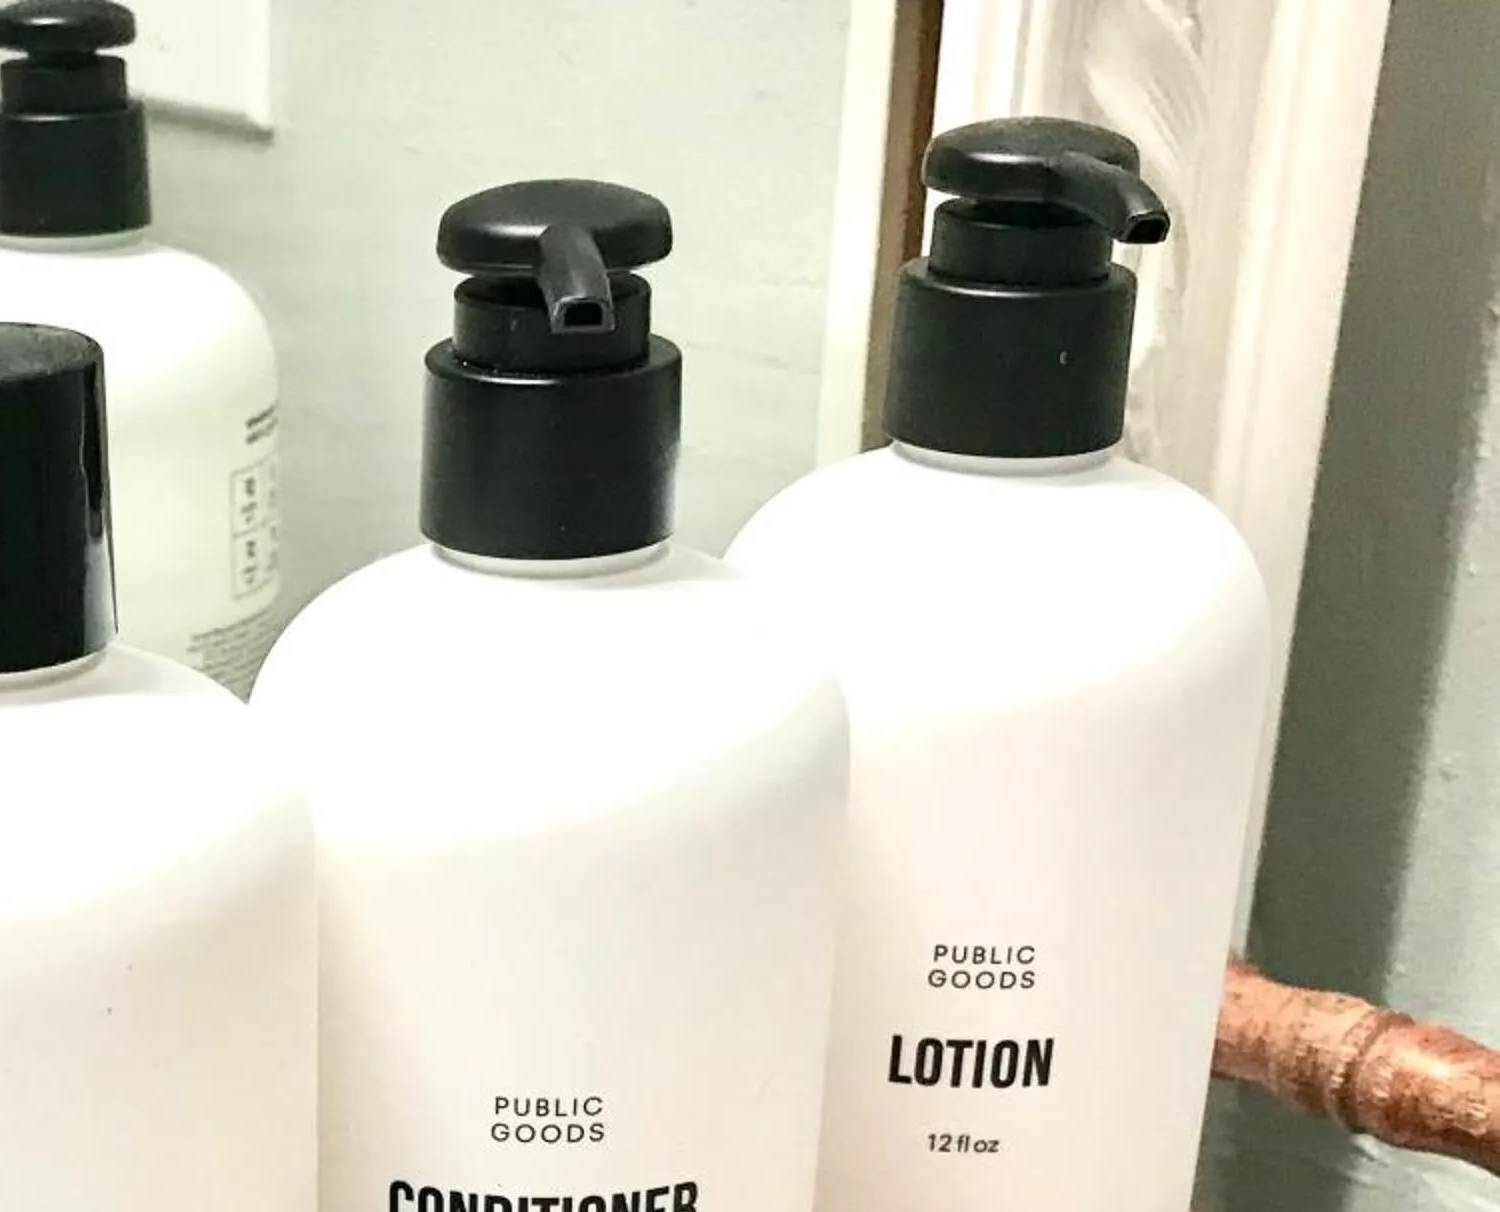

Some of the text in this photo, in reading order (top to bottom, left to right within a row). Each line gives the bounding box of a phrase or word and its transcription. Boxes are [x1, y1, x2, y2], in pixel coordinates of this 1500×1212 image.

[933, 944, 1035, 965] PUBLIC
[927, 968, 1035, 990] GOODS
[887, 1034, 1055, 1089] LOTION
[495, 1096, 603, 1118] PUBLIC
[491, 1122, 605, 1144] GOODS
[928, 1133, 1000, 1153] 12 fl oz
